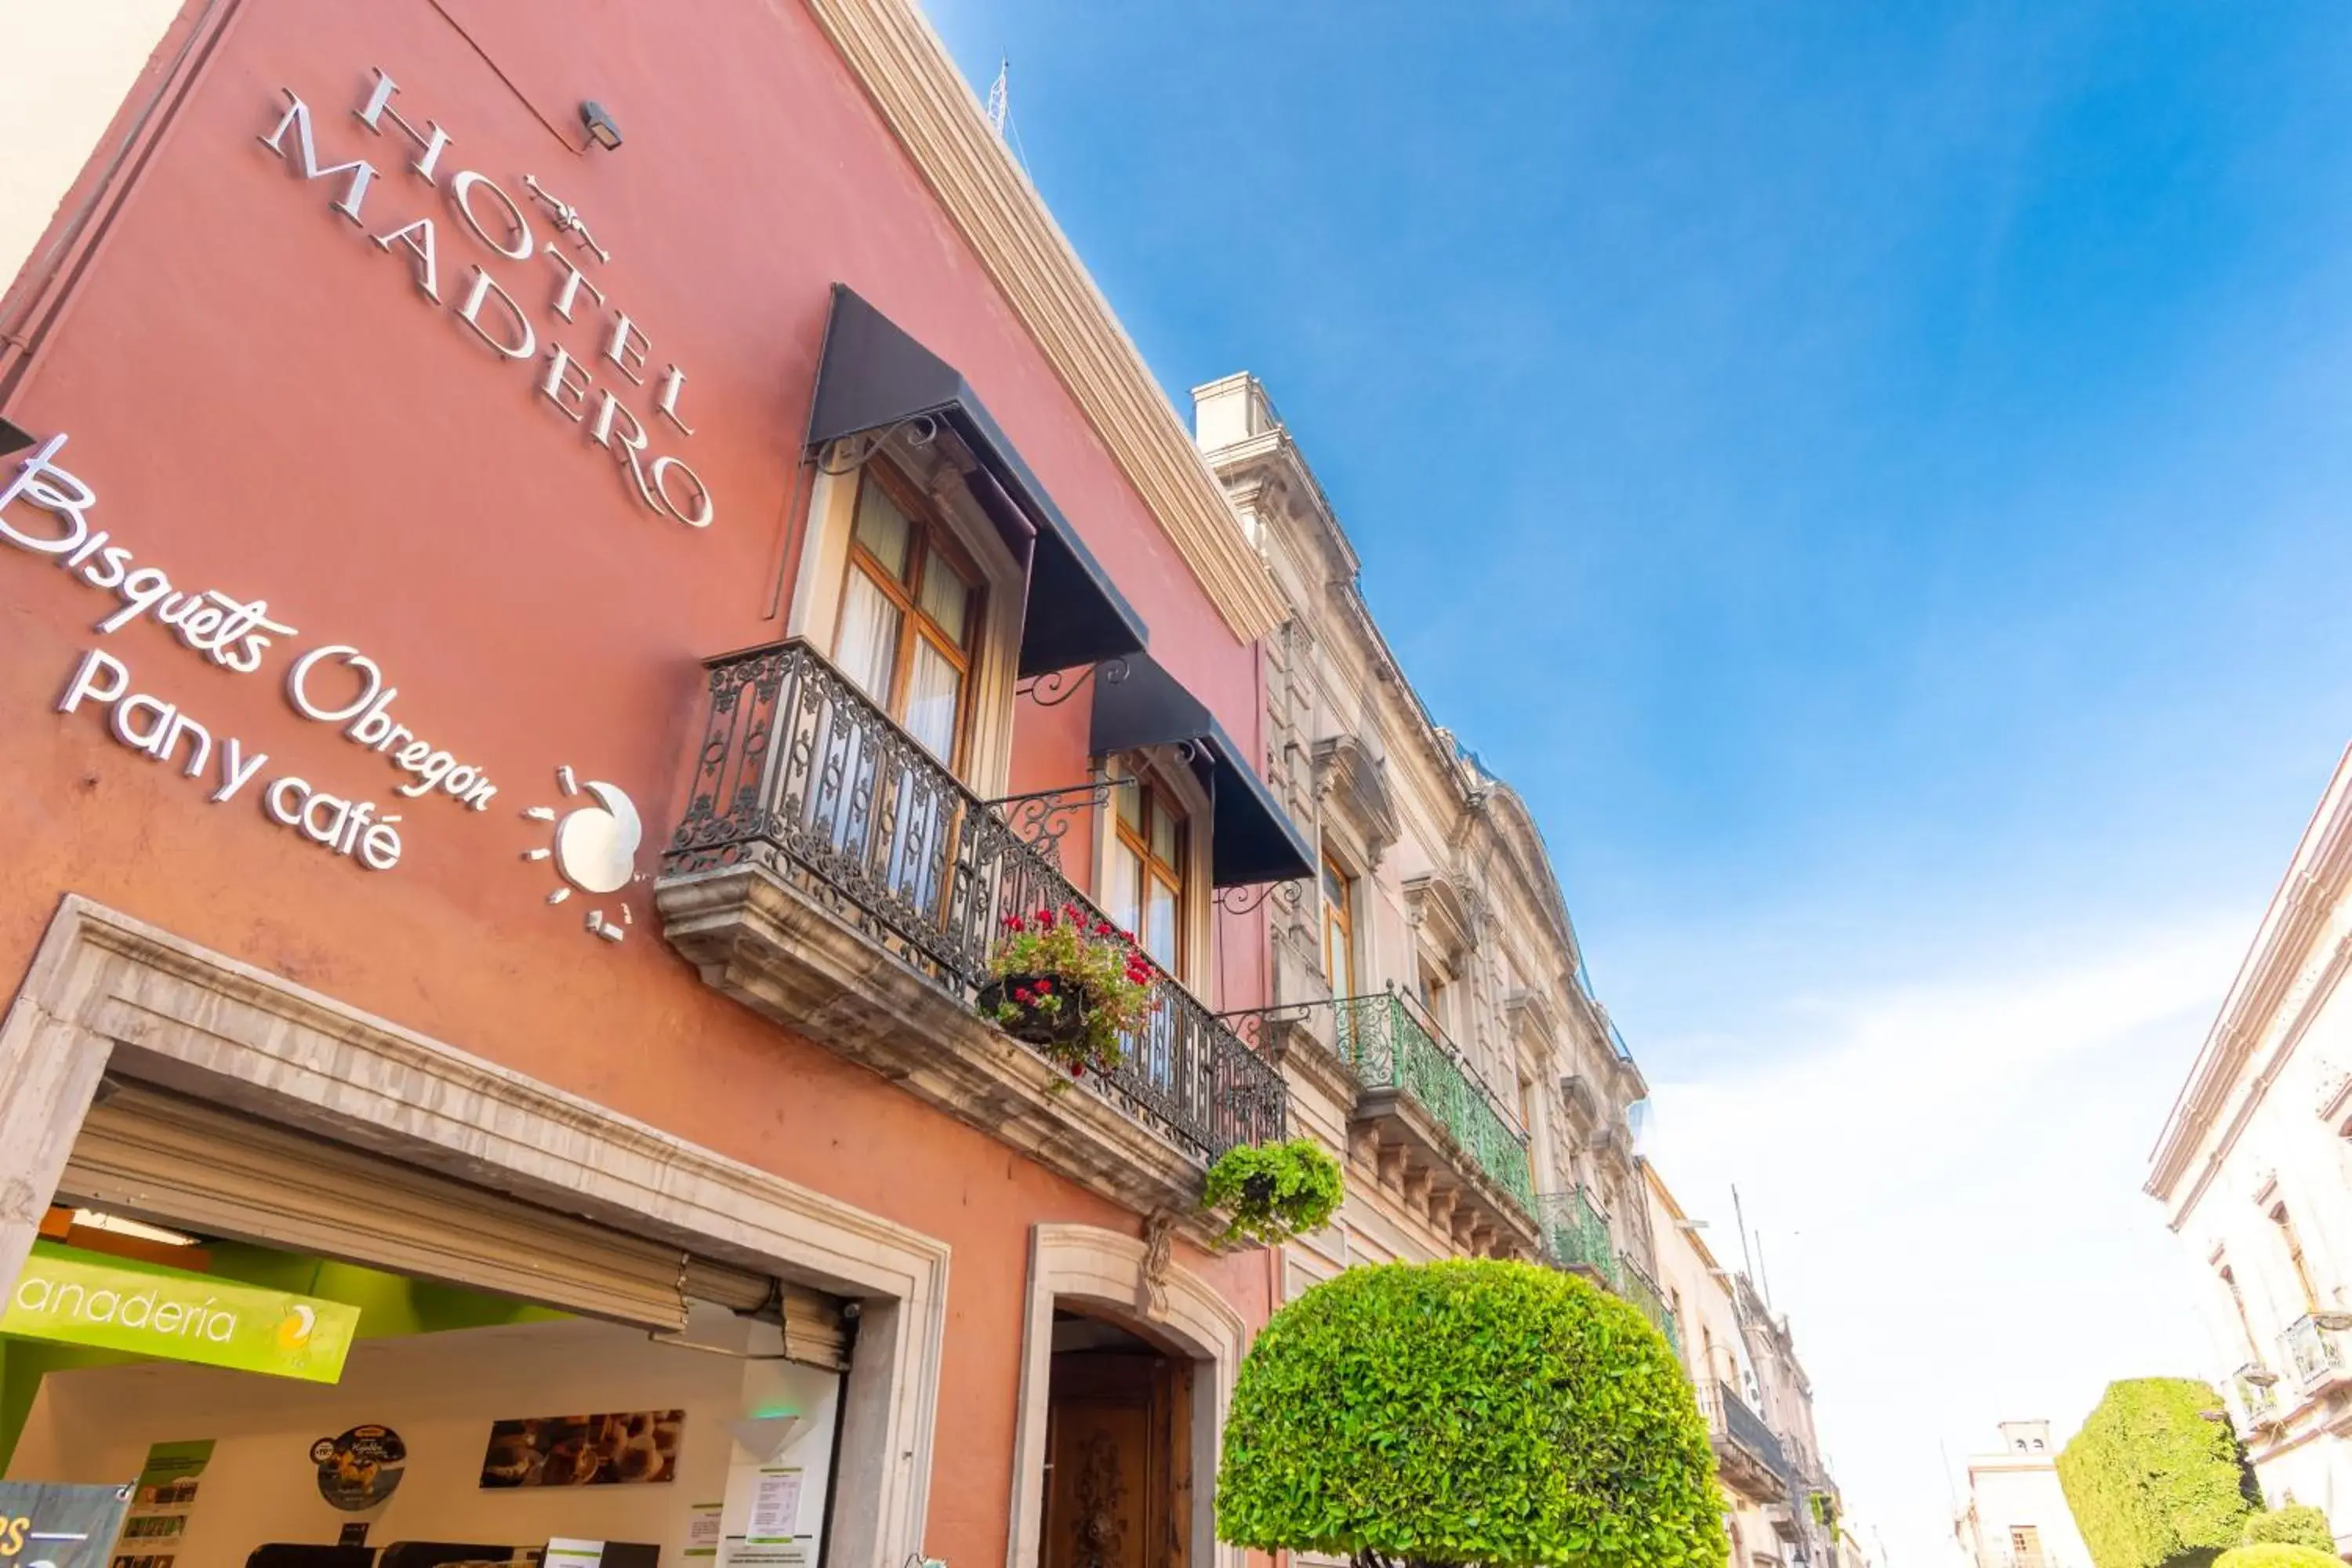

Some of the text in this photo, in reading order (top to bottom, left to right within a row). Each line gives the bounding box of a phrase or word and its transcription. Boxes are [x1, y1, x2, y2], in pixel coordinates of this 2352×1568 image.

[257, 87, 713, 528] MADERO
[353, 67, 695, 436] HOTEL
[60, 649, 403, 870] Pan y café
[288, 645, 498, 811] Obregón
